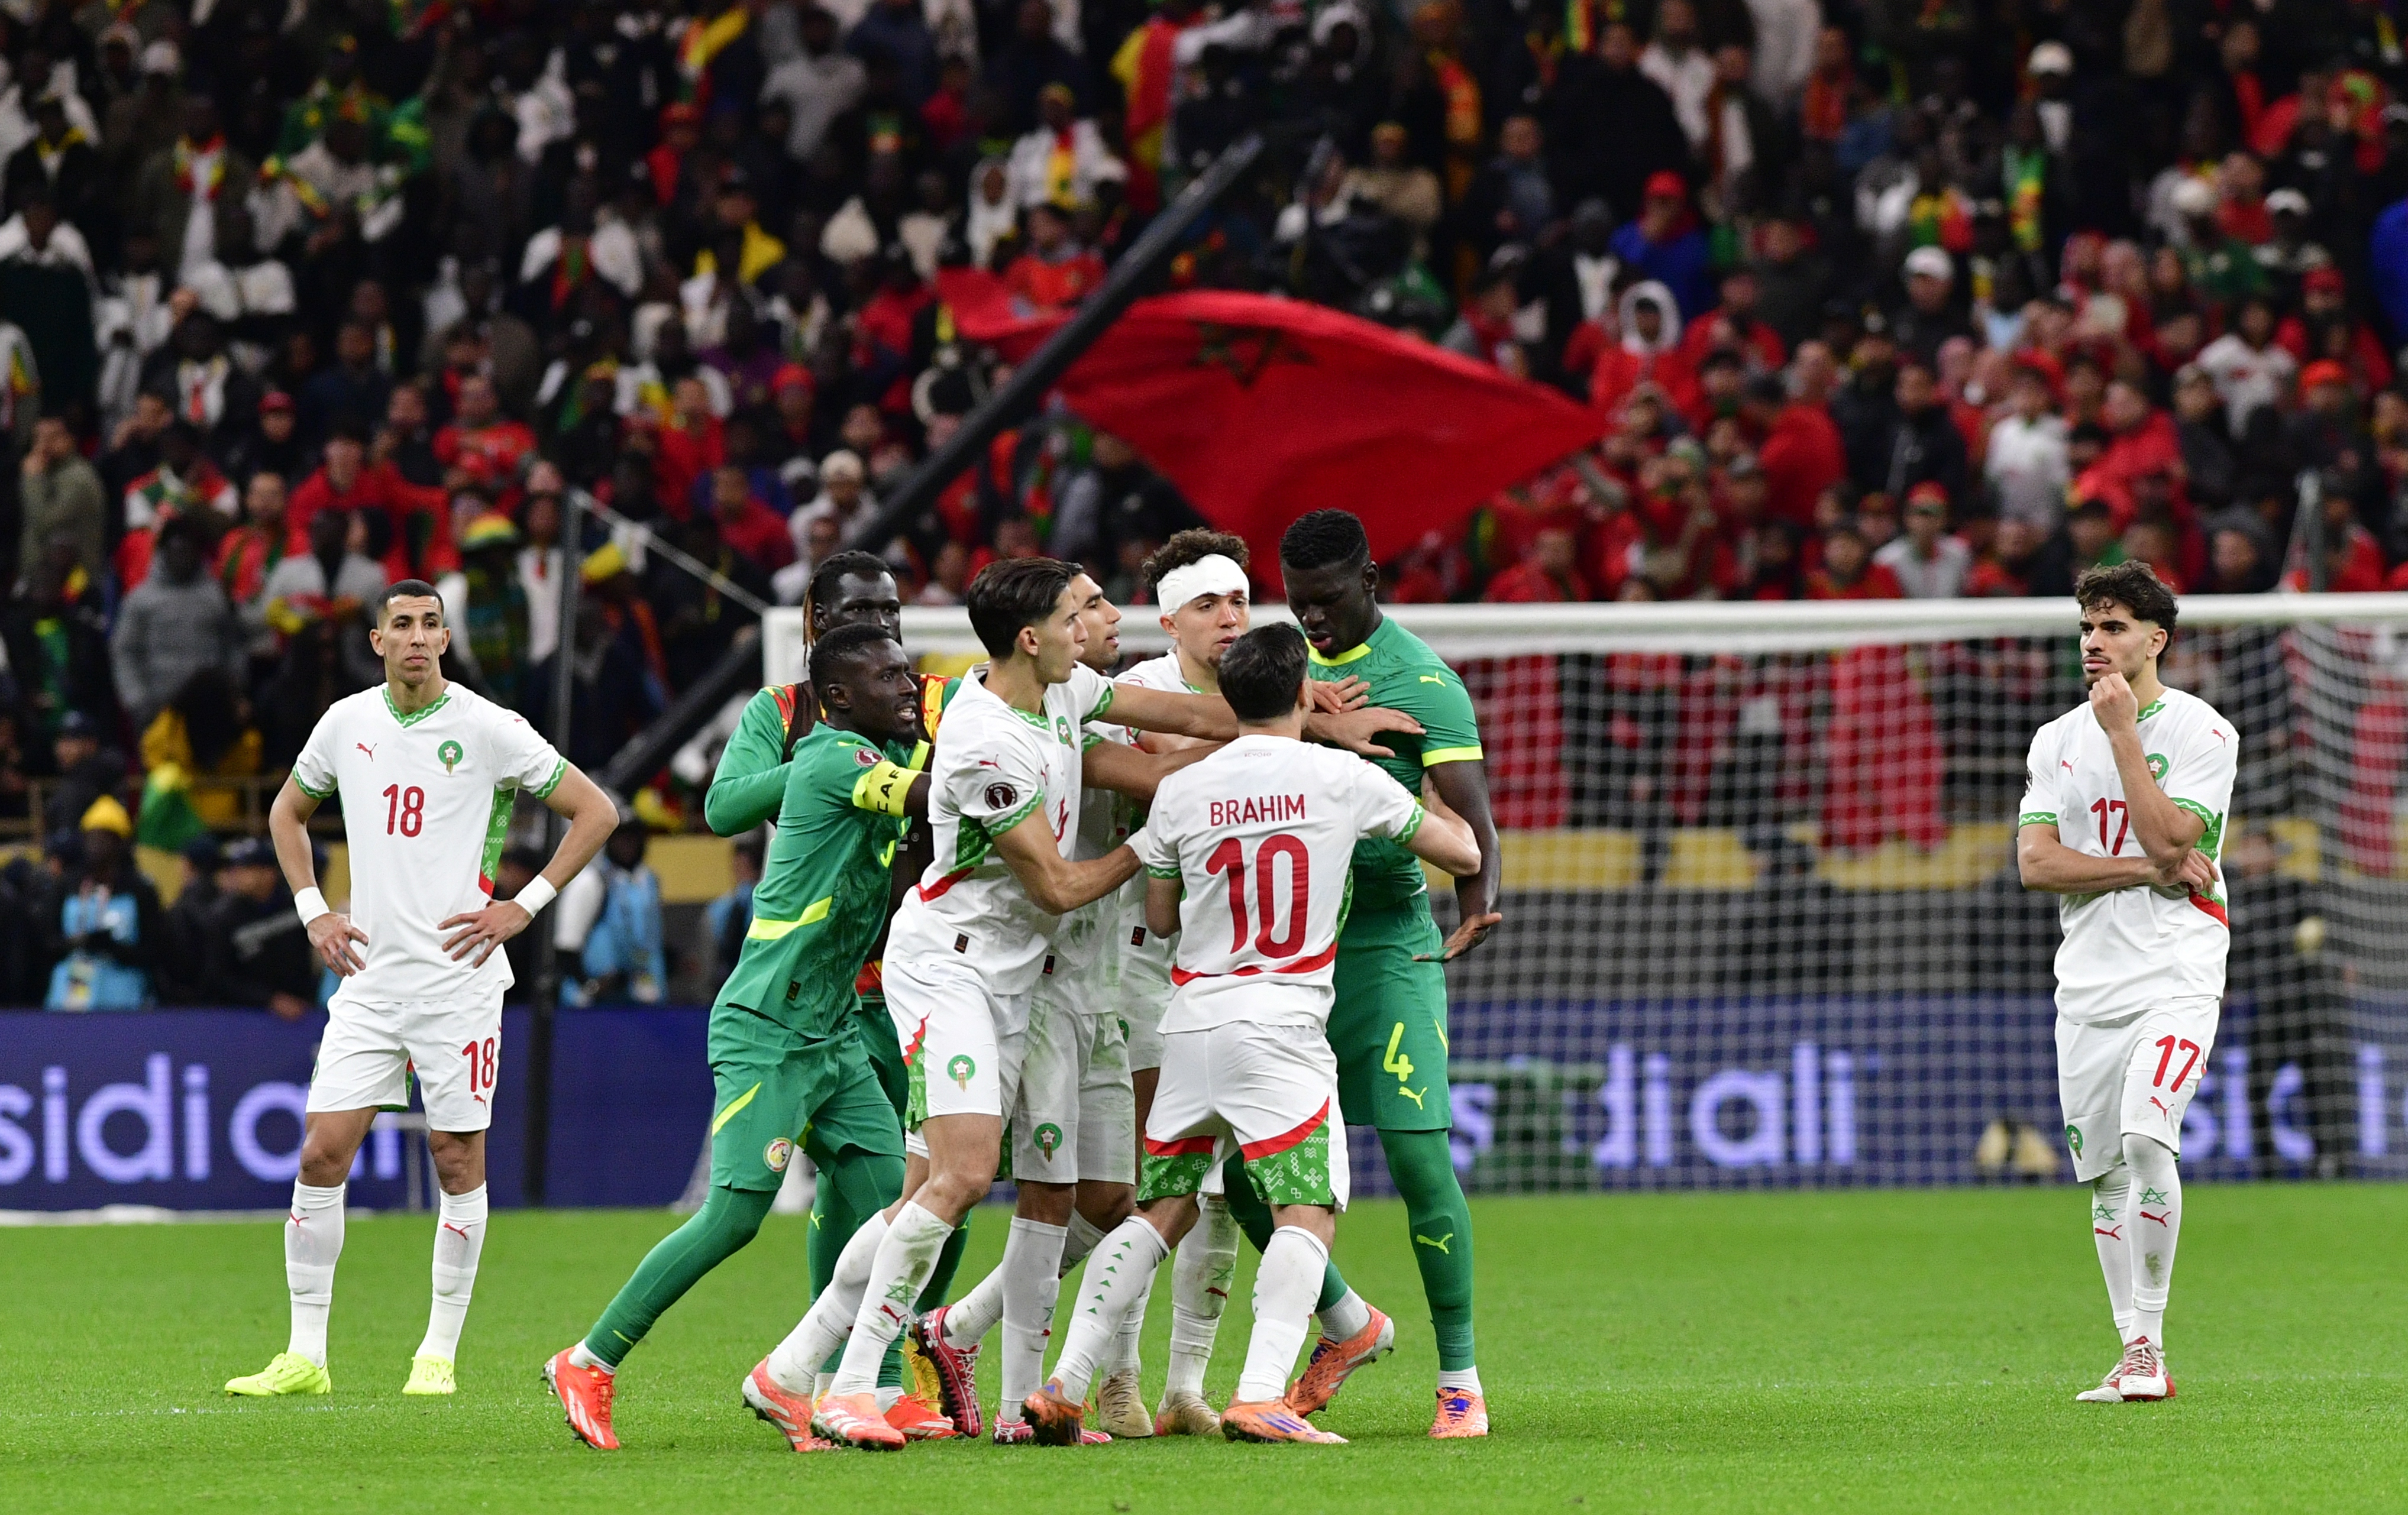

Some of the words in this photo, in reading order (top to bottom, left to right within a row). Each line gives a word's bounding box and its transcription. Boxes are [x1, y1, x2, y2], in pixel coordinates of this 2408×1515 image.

[383, 784, 425, 837] 18
[877, 769, 901, 814] CAF
[1210, 794, 1306, 827] BRAHIM
[2090, 797, 2129, 856] 17
[1205, 833, 1310, 959] 10
[461, 1037, 496, 1093] 18
[1383, 1021, 1414, 1082] 4
[2152, 1034, 2201, 1093] 17
